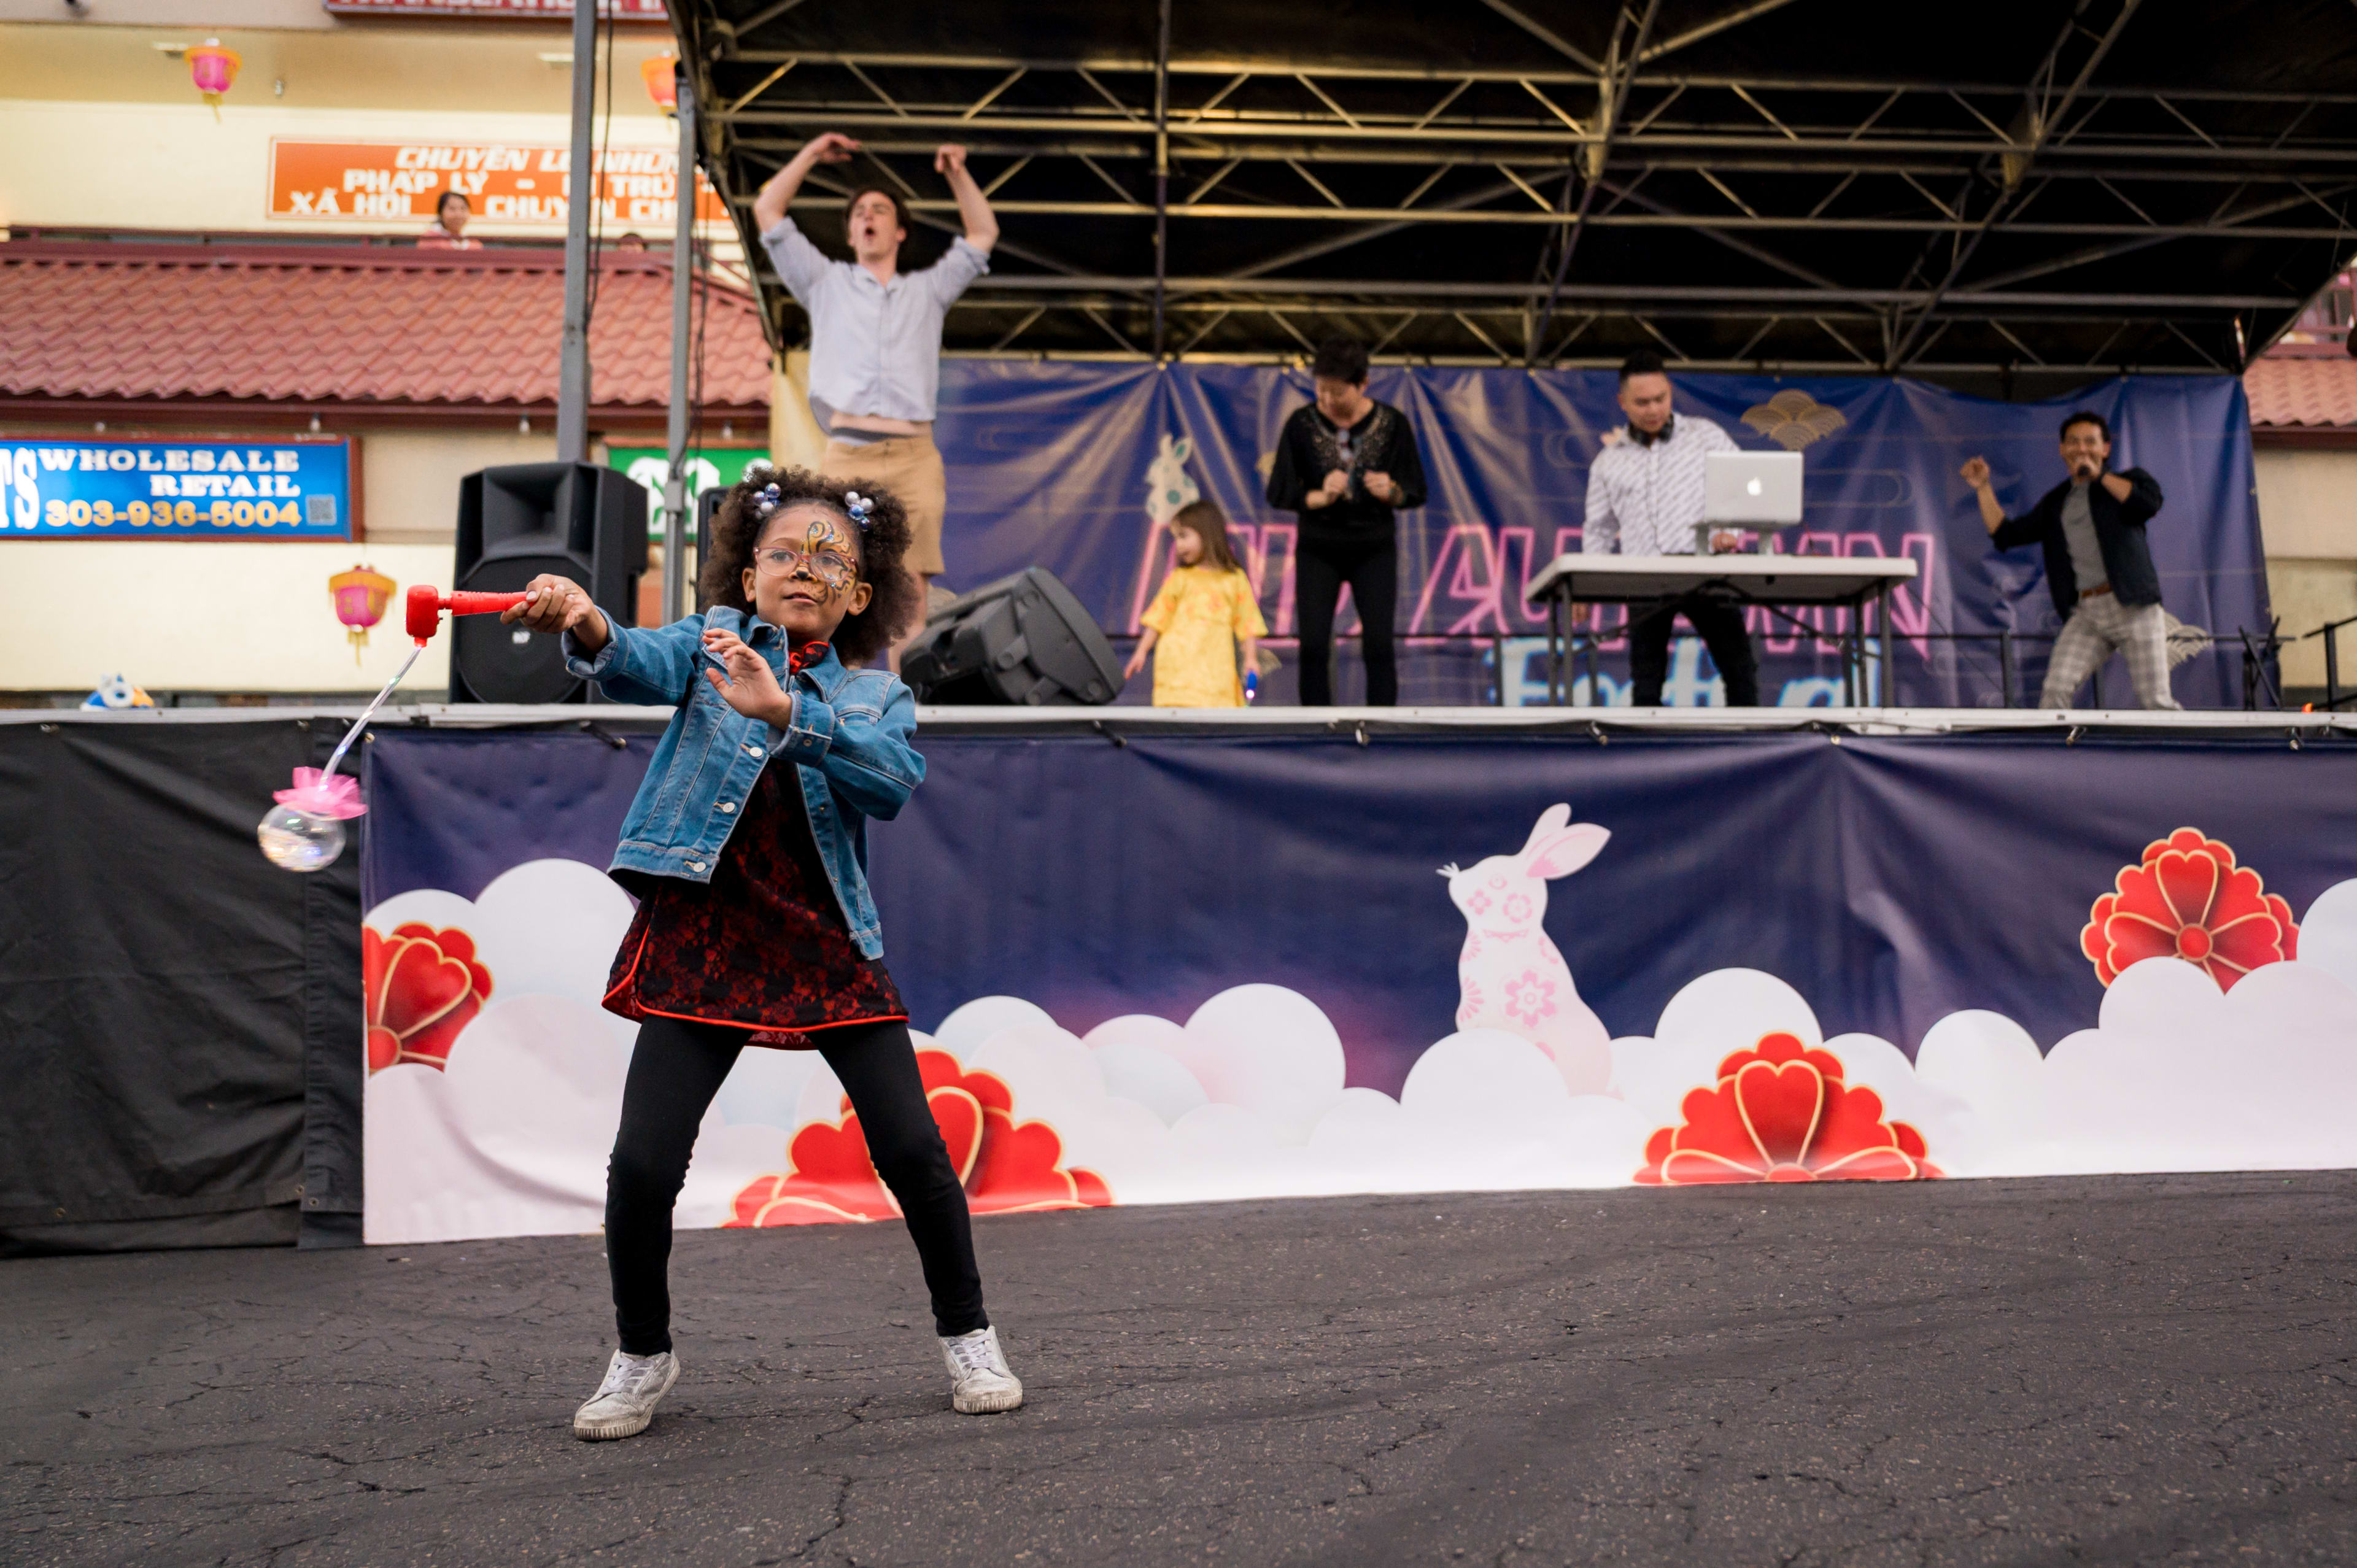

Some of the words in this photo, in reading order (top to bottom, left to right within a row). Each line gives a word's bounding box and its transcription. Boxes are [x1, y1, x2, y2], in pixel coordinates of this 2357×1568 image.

[396, 144, 530, 171] CHUYÊN
[344, 168, 438, 194] PHÁP
[485, 196, 616, 219] CHUYN
[37, 449, 300, 472] WHOLESALE
[150, 474, 301, 497] RETAIL
[45, 499, 303, 527] 303-936-5004
